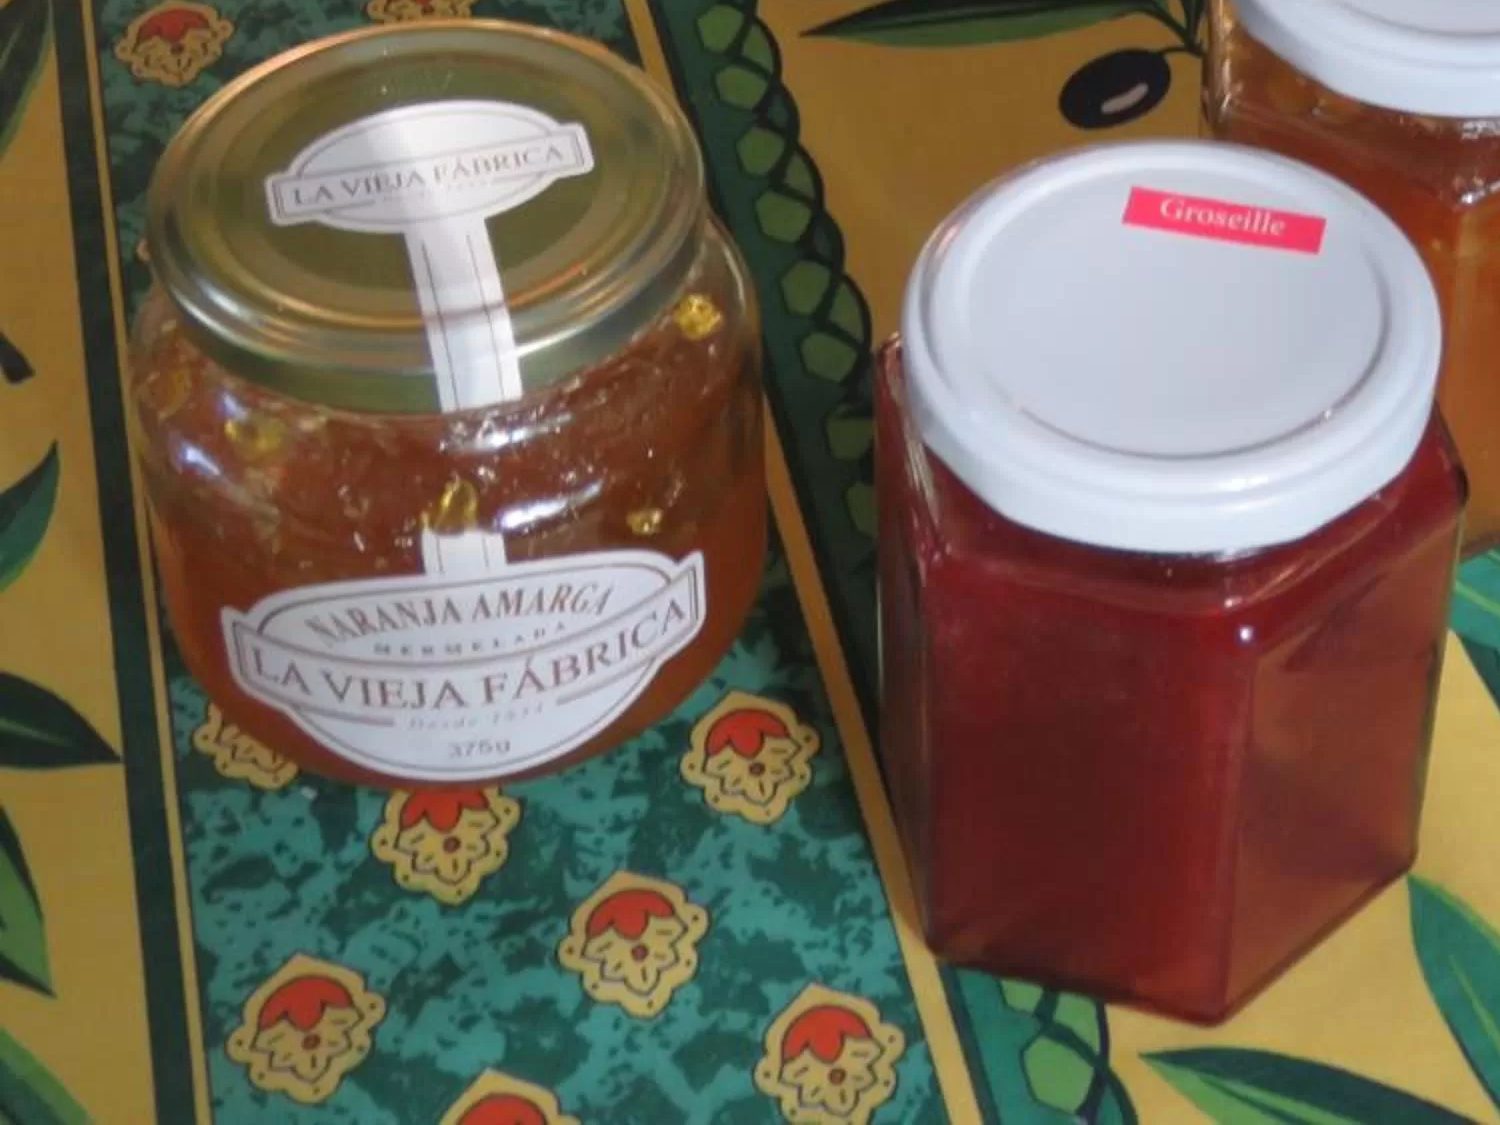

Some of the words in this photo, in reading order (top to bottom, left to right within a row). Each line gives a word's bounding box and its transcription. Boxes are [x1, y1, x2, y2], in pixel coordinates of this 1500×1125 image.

[293, 184, 334, 207] LA
[339, 170, 425, 198] VIEJA
[1159, 196, 1288, 236] Groseille
[304, 594, 461, 648] NARANJA
[471, 581, 616, 623] AMARGA
[251, 646, 312, 697] LA
[322, 670, 468, 711] VIEJA
[481, 596, 687, 706] FÁBRICA
